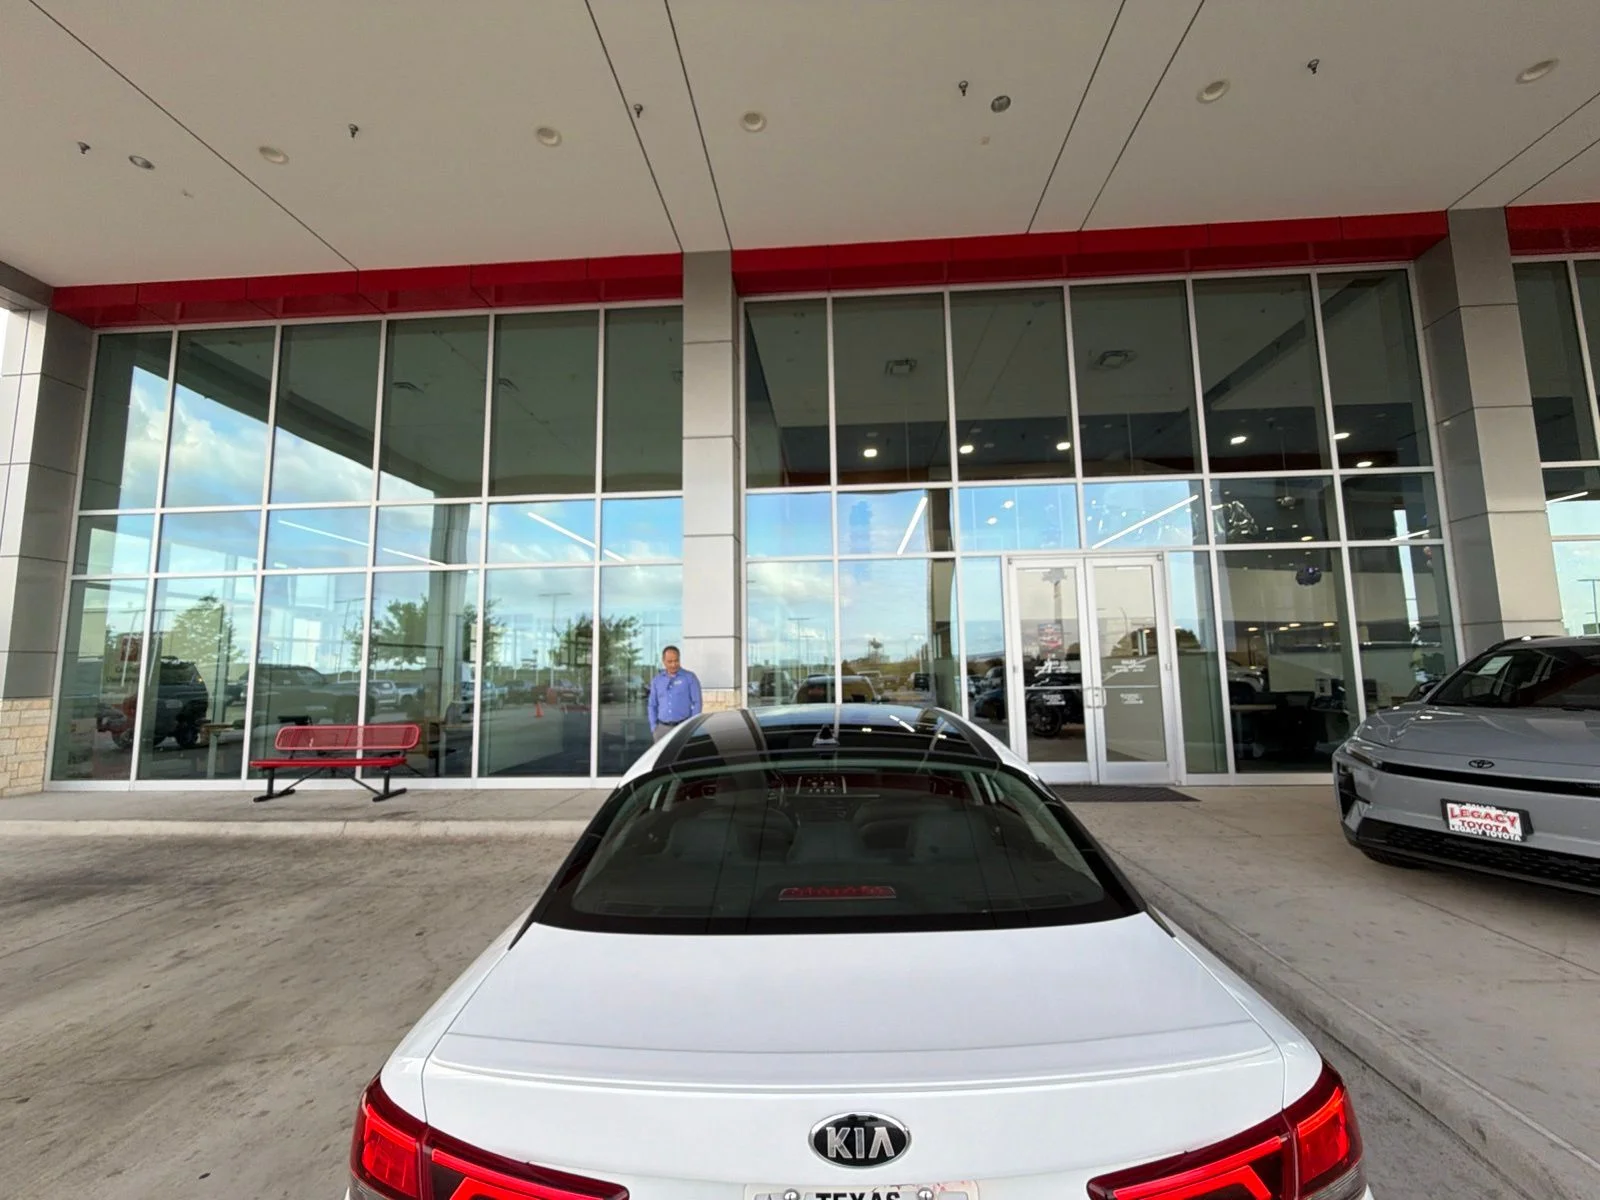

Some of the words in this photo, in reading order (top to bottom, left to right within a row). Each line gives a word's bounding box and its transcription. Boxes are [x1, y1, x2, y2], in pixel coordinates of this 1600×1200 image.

[1449, 807, 1517, 827] LEGACY
[1459, 819, 1510, 833] TOYOTA
[1450, 825, 1483, 835] LEGACY
[1485, 830, 1522, 841] TOYOTA
[826, 1126, 895, 1158] KIA
